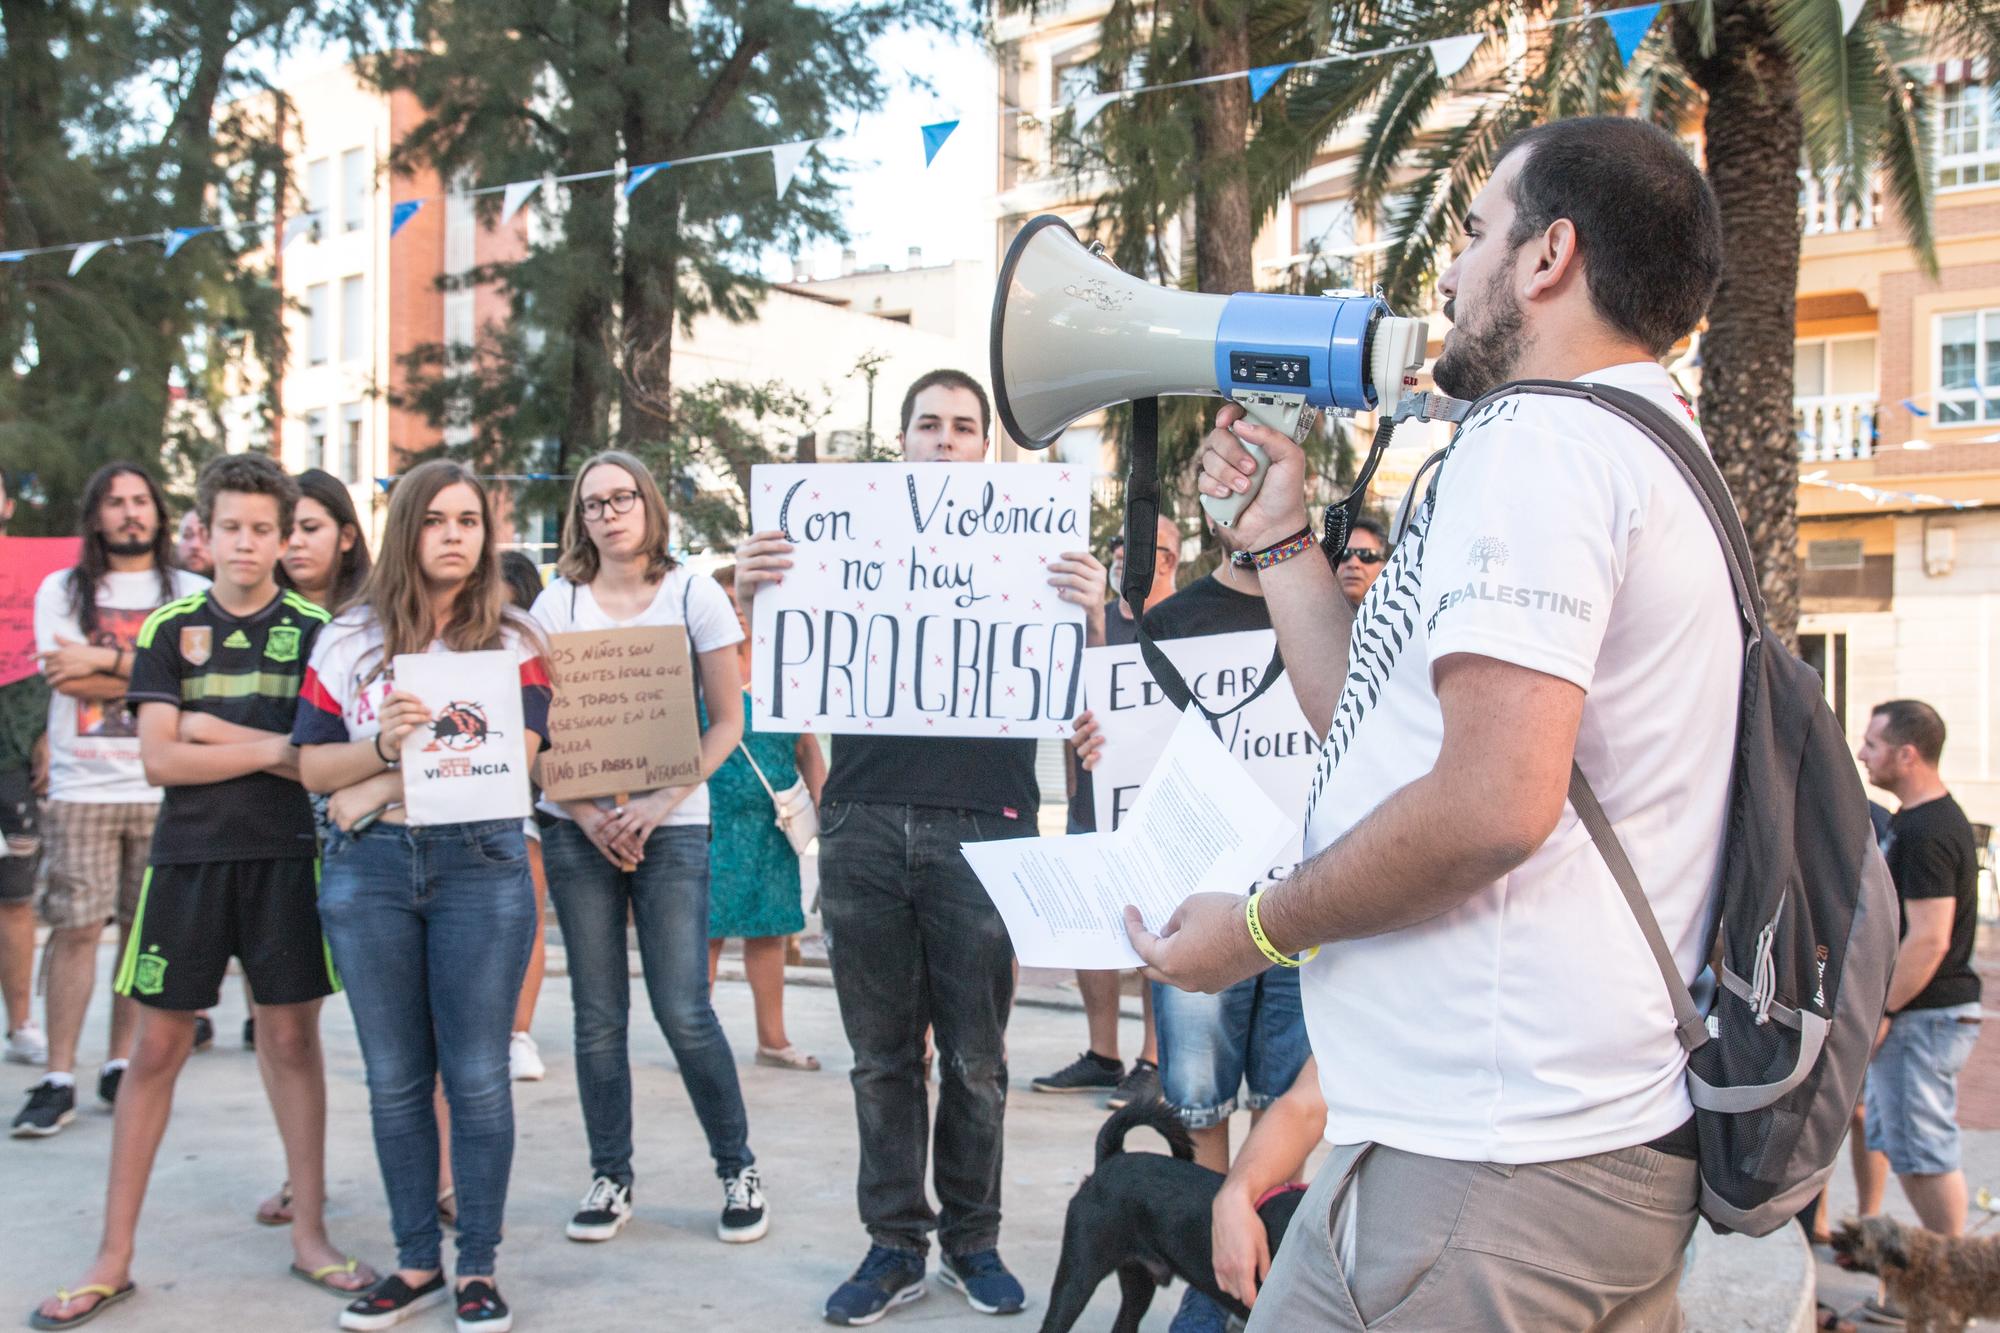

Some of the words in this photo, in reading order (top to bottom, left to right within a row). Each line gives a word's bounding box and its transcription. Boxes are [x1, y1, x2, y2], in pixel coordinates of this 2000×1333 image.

[779, 478, 857, 544] Con
[906, 473, 1082, 538] Violencia
[839, 557, 885, 592] no
[908, 545, 991, 608] hay
[551, 648, 575, 665] OS
[628, 643, 655, 657] SON
[767, 609, 1085, 720] PROGRESO
[655, 664, 683, 676] QUE
[1110, 660, 1265, 712] EDCAR
[551, 696, 571, 708] OS
[577, 691, 629, 708] TOROS
[635, 688, 665, 703] QUE
[624, 709, 645, 724] EN
[649, 707, 667, 721] LA
[424, 762, 510, 779] VIOLENCIA
[578, 762, 598, 779] LES
